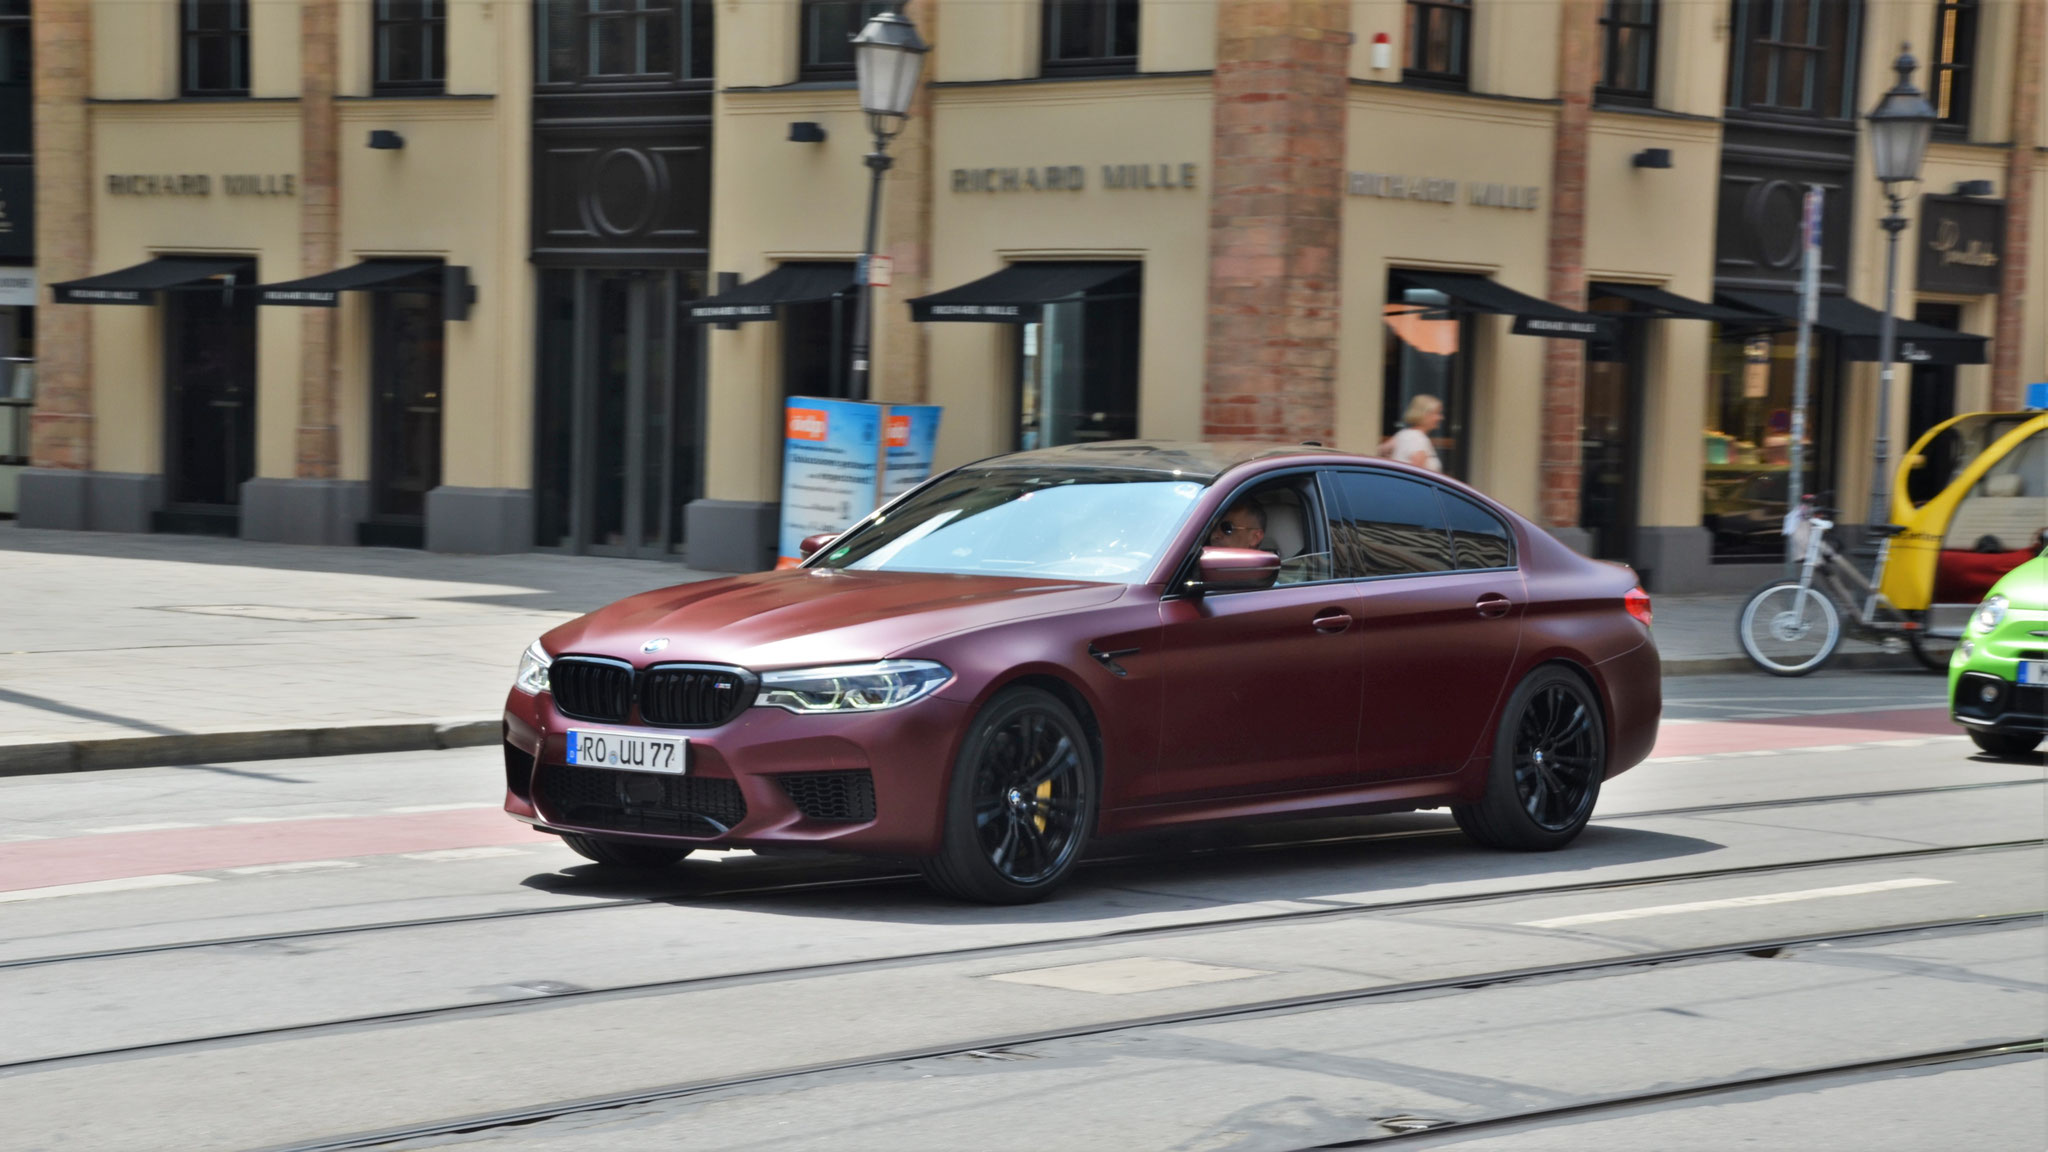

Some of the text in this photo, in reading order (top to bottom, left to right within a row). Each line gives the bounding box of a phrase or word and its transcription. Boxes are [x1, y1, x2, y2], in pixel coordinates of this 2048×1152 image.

[106, 174, 297, 197] RICHARD MILLE
[952, 163, 1198, 193] RICHARD MILLE
[583, 737, 674, 768] RO UU 77
